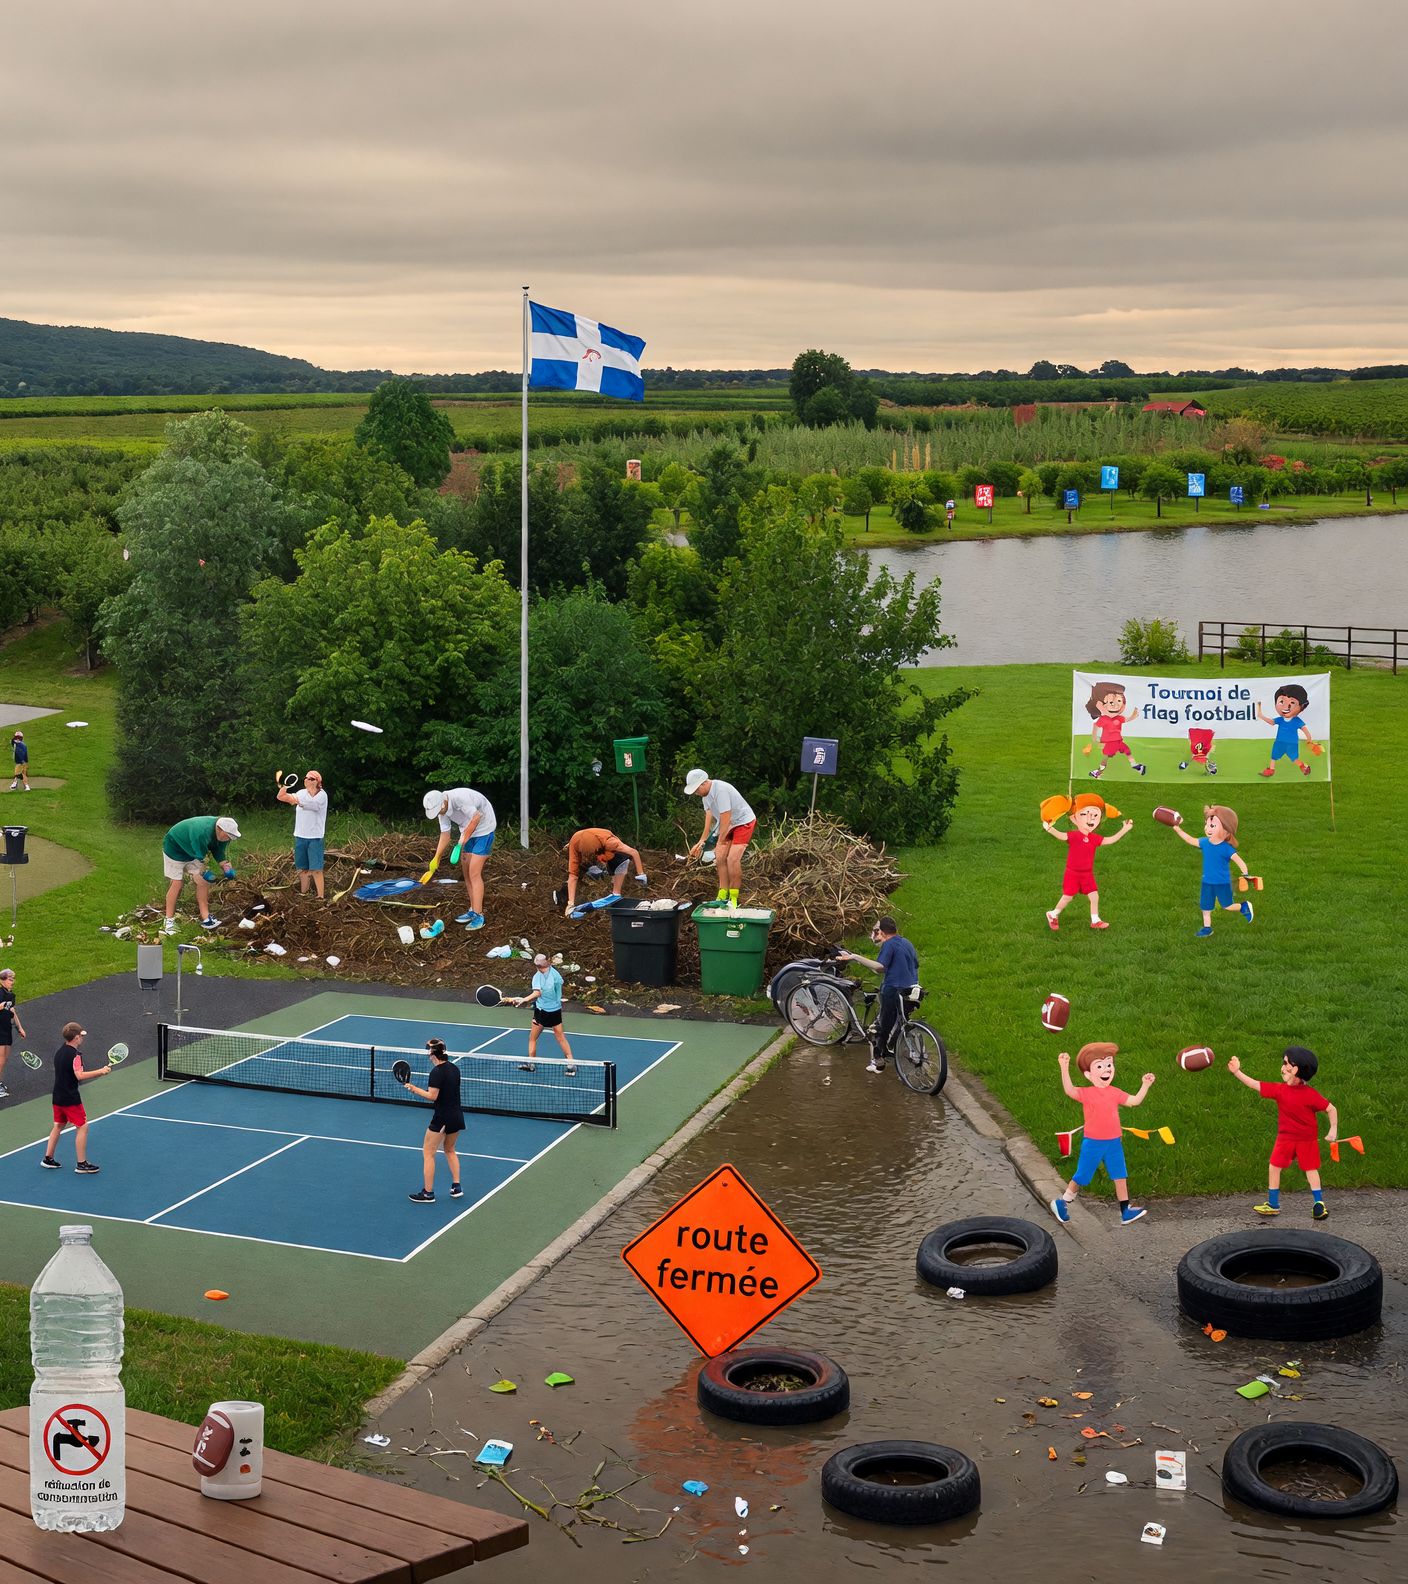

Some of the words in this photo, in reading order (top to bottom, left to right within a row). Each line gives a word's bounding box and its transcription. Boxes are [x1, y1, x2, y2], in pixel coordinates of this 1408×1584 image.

[1228, 685, 1251, 701] de
[1142, 703, 1179, 725] flag
[1185, 703, 1257, 722] football
[676, 1224, 769, 1256] route
[656, 1257, 779, 1299] fermée
